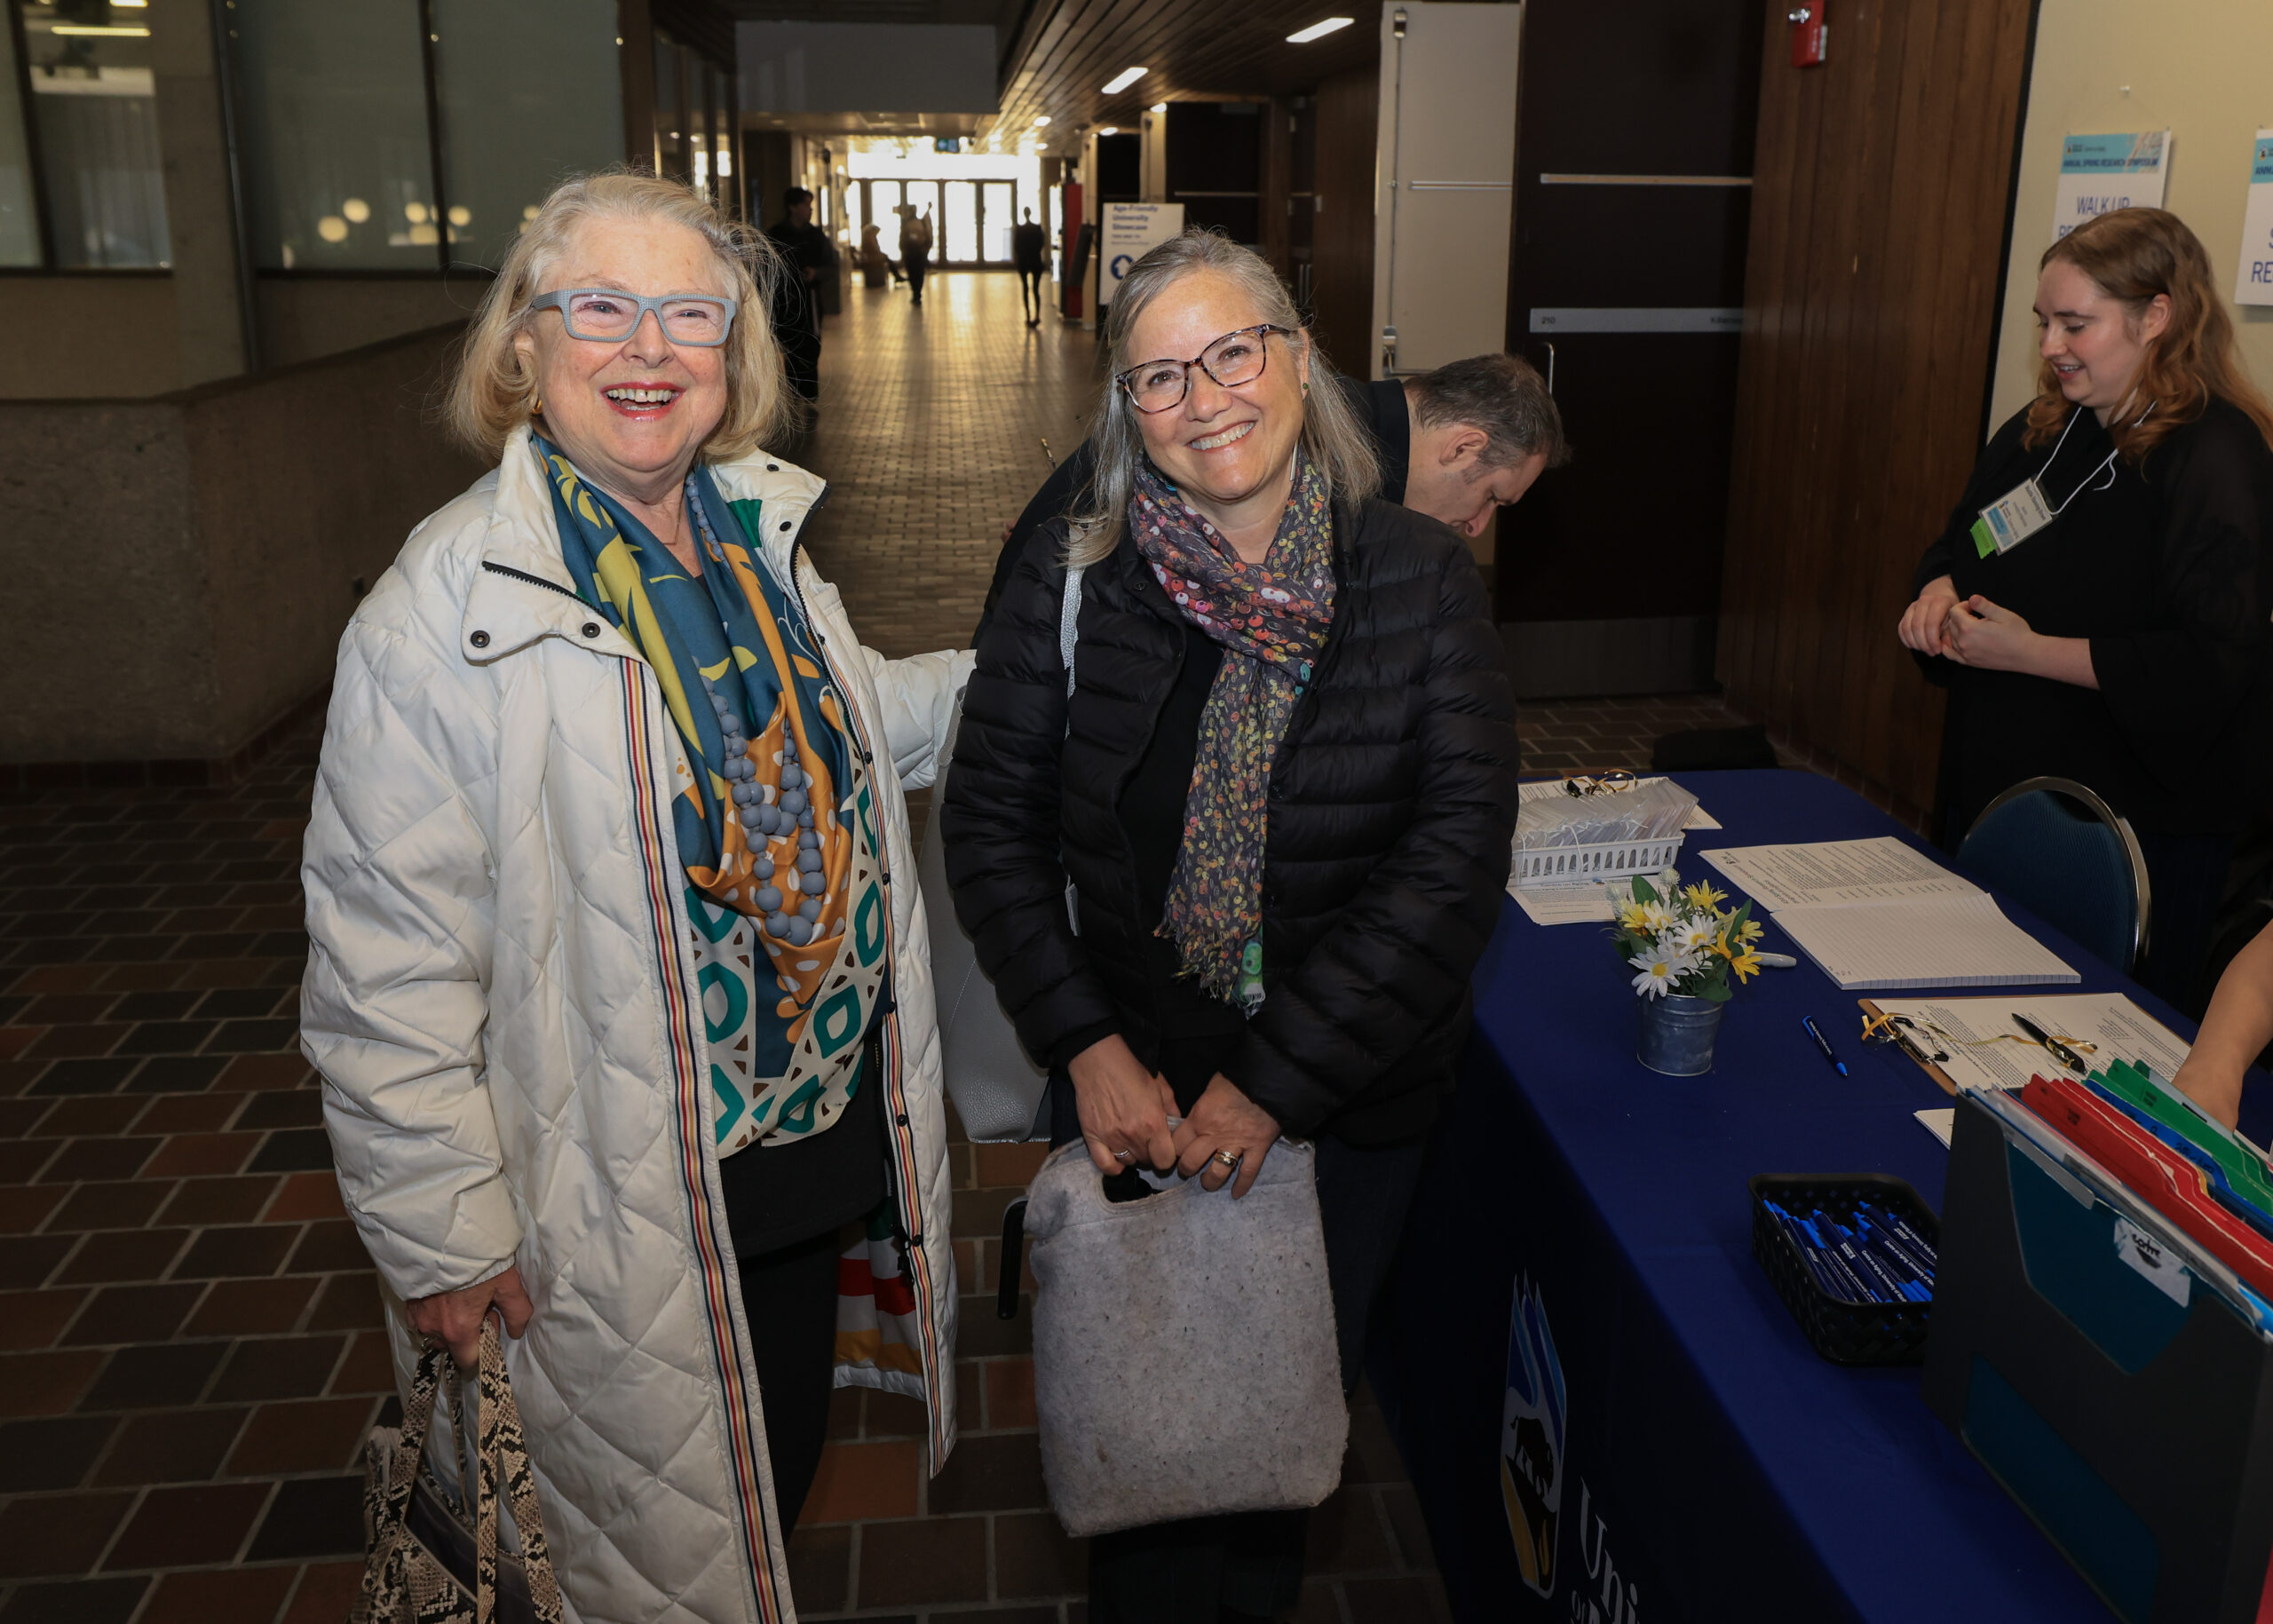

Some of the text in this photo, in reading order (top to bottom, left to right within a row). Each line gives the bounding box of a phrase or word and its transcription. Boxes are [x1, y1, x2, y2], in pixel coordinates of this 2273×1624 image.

[2077, 196, 2109, 216] WALK
[1908, 1262, 1925, 1277] University
[1881, 1273, 1896, 1291] University
